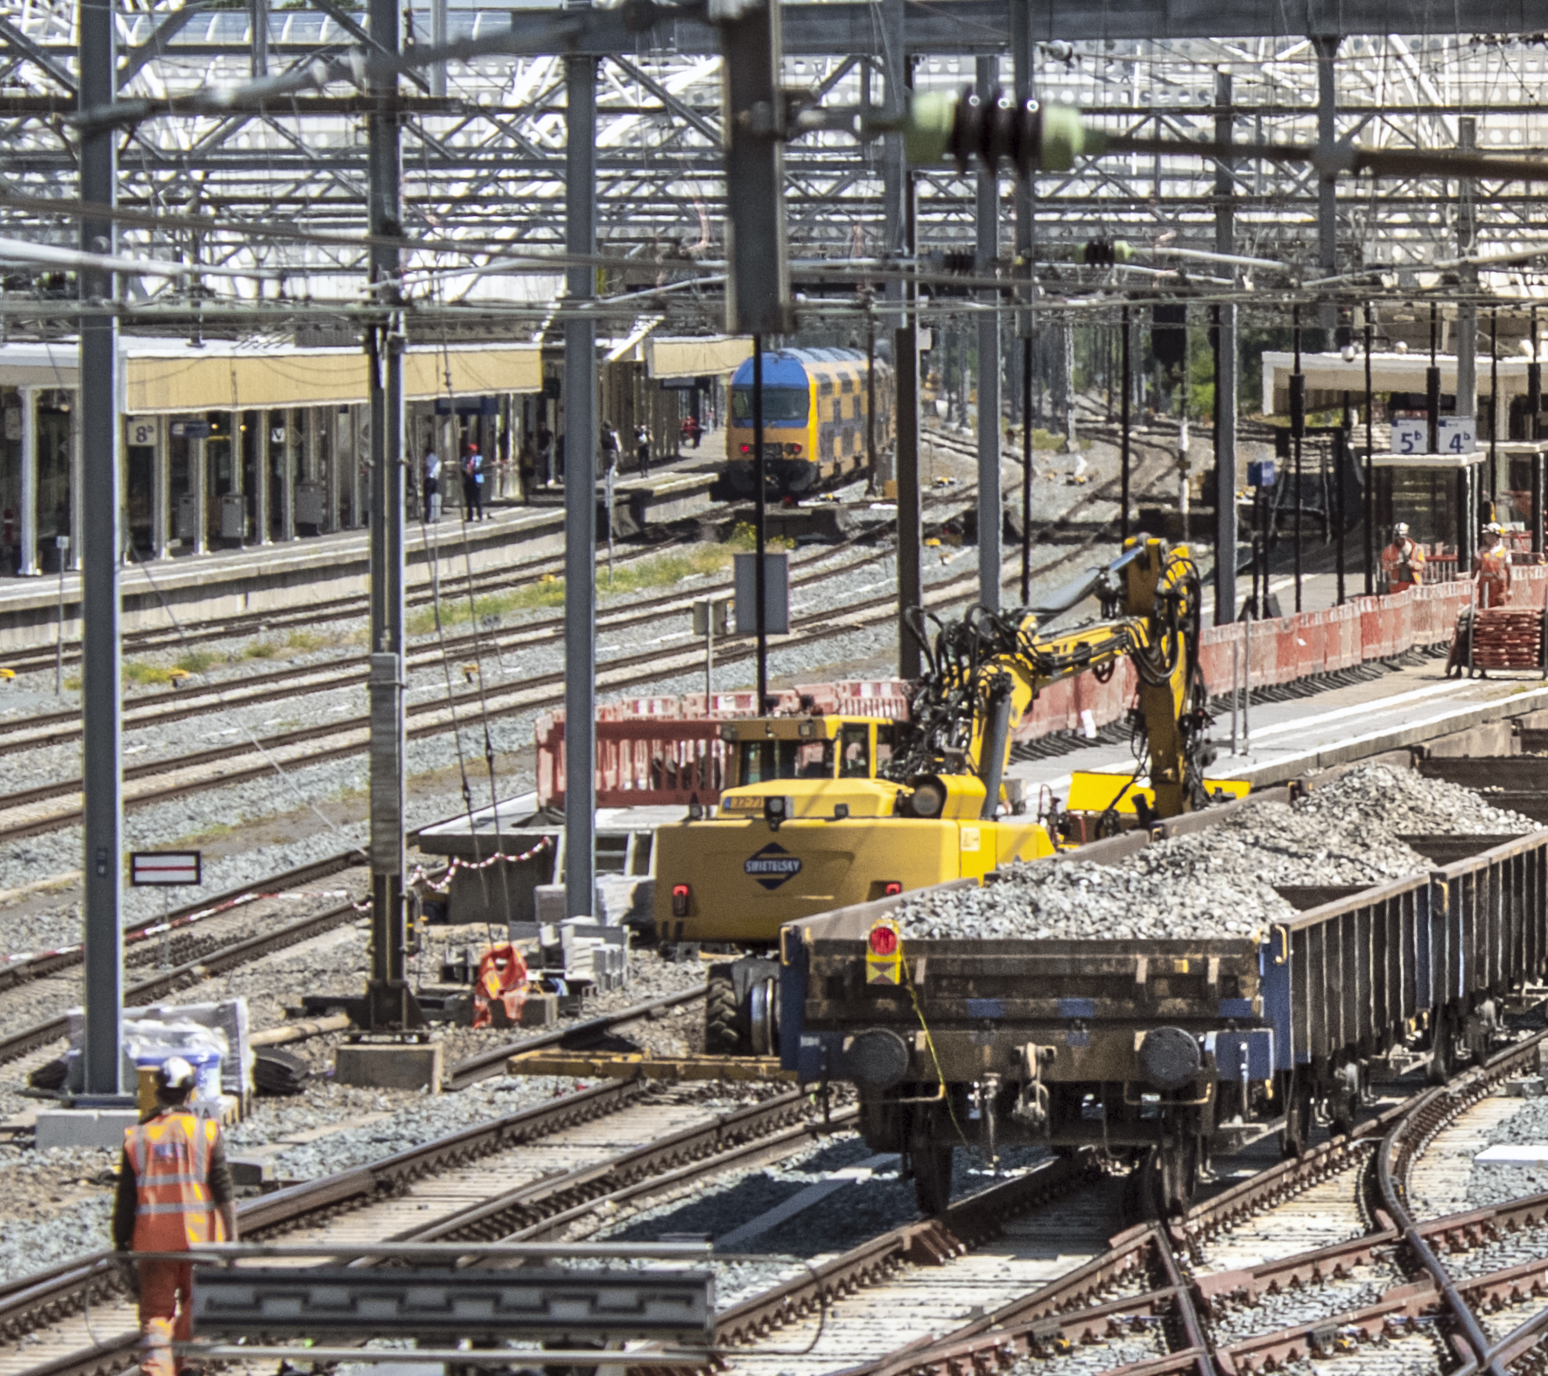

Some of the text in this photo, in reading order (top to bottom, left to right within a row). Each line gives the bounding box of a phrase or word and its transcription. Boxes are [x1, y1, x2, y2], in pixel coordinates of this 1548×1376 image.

[1401, 430, 1423, 454] 5b
[1449, 430, 1471, 454] 4b
[745, 860, 799, 873] SWIETELSKY
